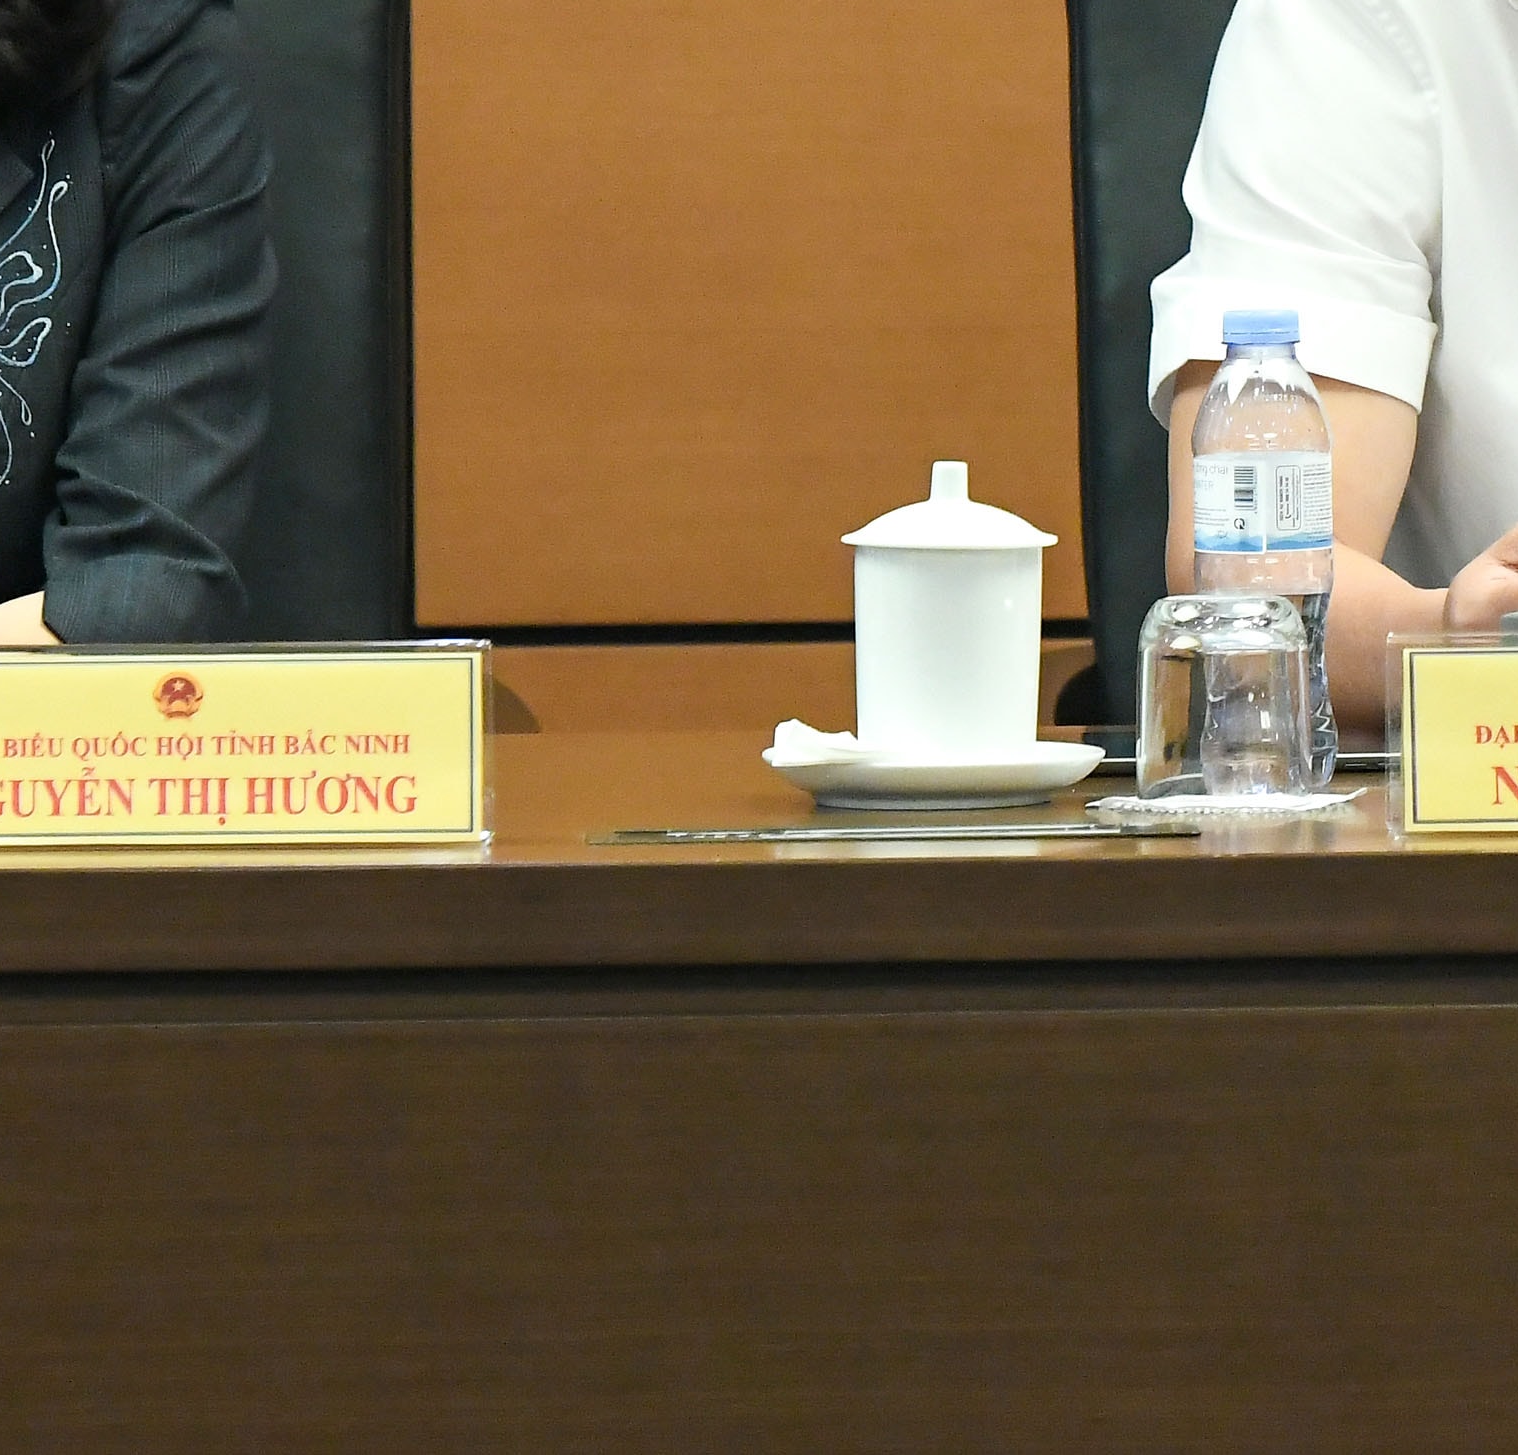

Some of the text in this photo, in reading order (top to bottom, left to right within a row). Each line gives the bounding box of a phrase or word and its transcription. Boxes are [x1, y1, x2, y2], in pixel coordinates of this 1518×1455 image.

[3, 732, 64, 758] BIỂU
[72, 731, 147, 761] QUỐC
[156, 733, 204, 761] HỘI
[211, 730, 275, 756] TỈNH
[284, 728, 337, 756] BẮC
[344, 734, 411, 755] NINH
[149, 776, 230, 825] THỊ
[243, 770, 417, 816] HƯƠNG
